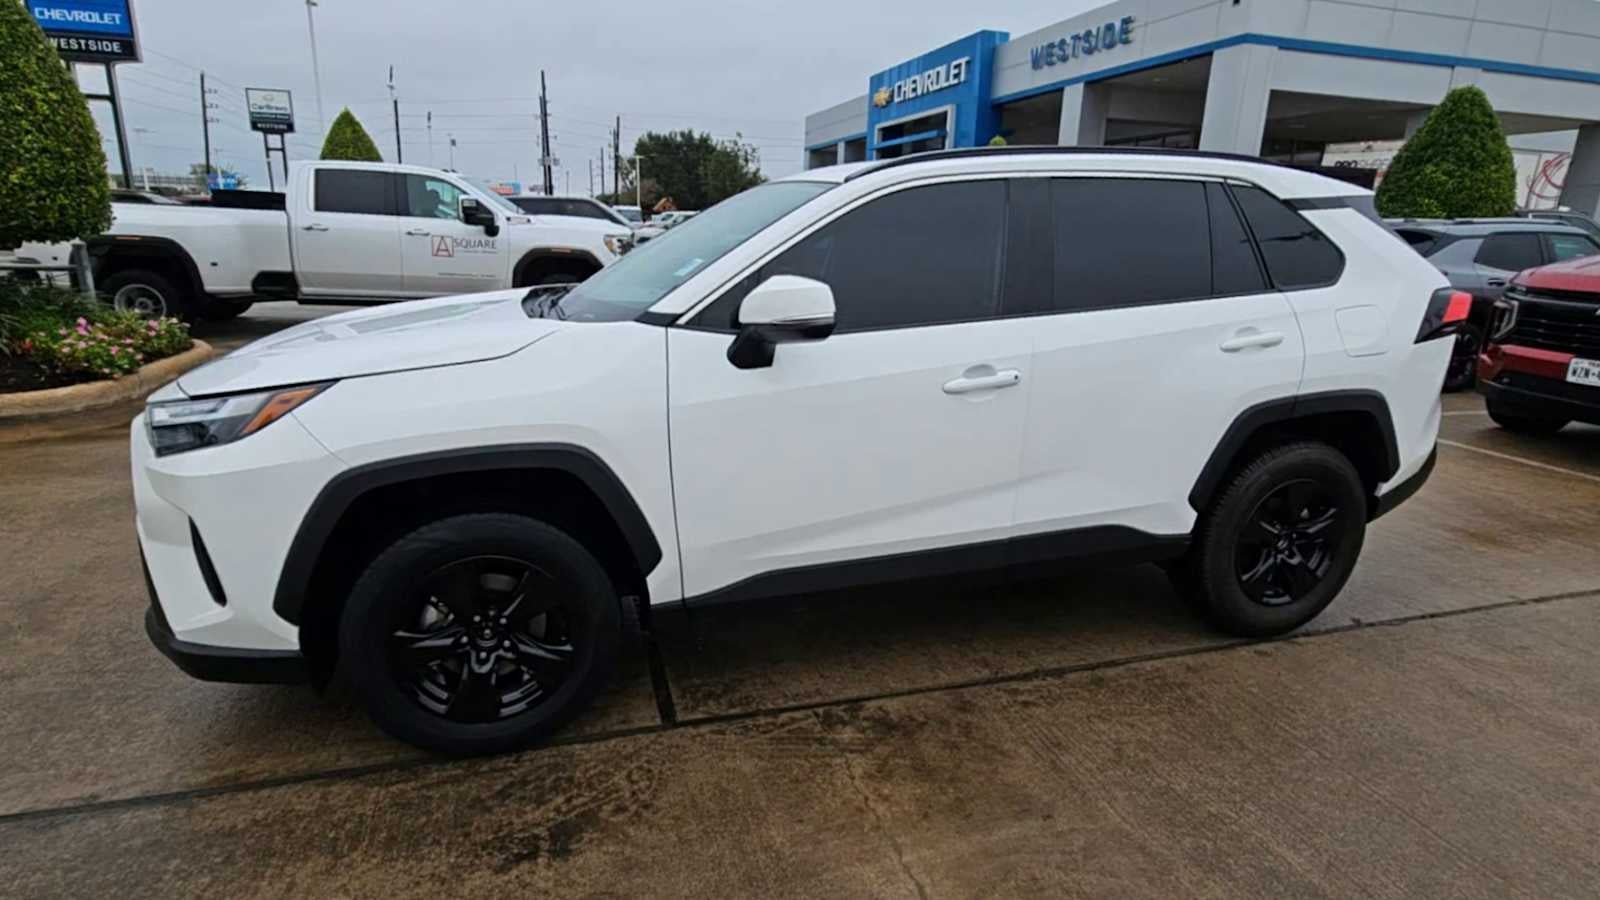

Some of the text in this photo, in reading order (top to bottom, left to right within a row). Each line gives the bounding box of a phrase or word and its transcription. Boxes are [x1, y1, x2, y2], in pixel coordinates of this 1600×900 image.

[34, 7, 121, 25] CHEVROLET
[1030, 15, 1135, 71] WESTSIDE
[894, 56, 970, 103] CHEVROLET
[454, 239, 497, 250] SQUARE
